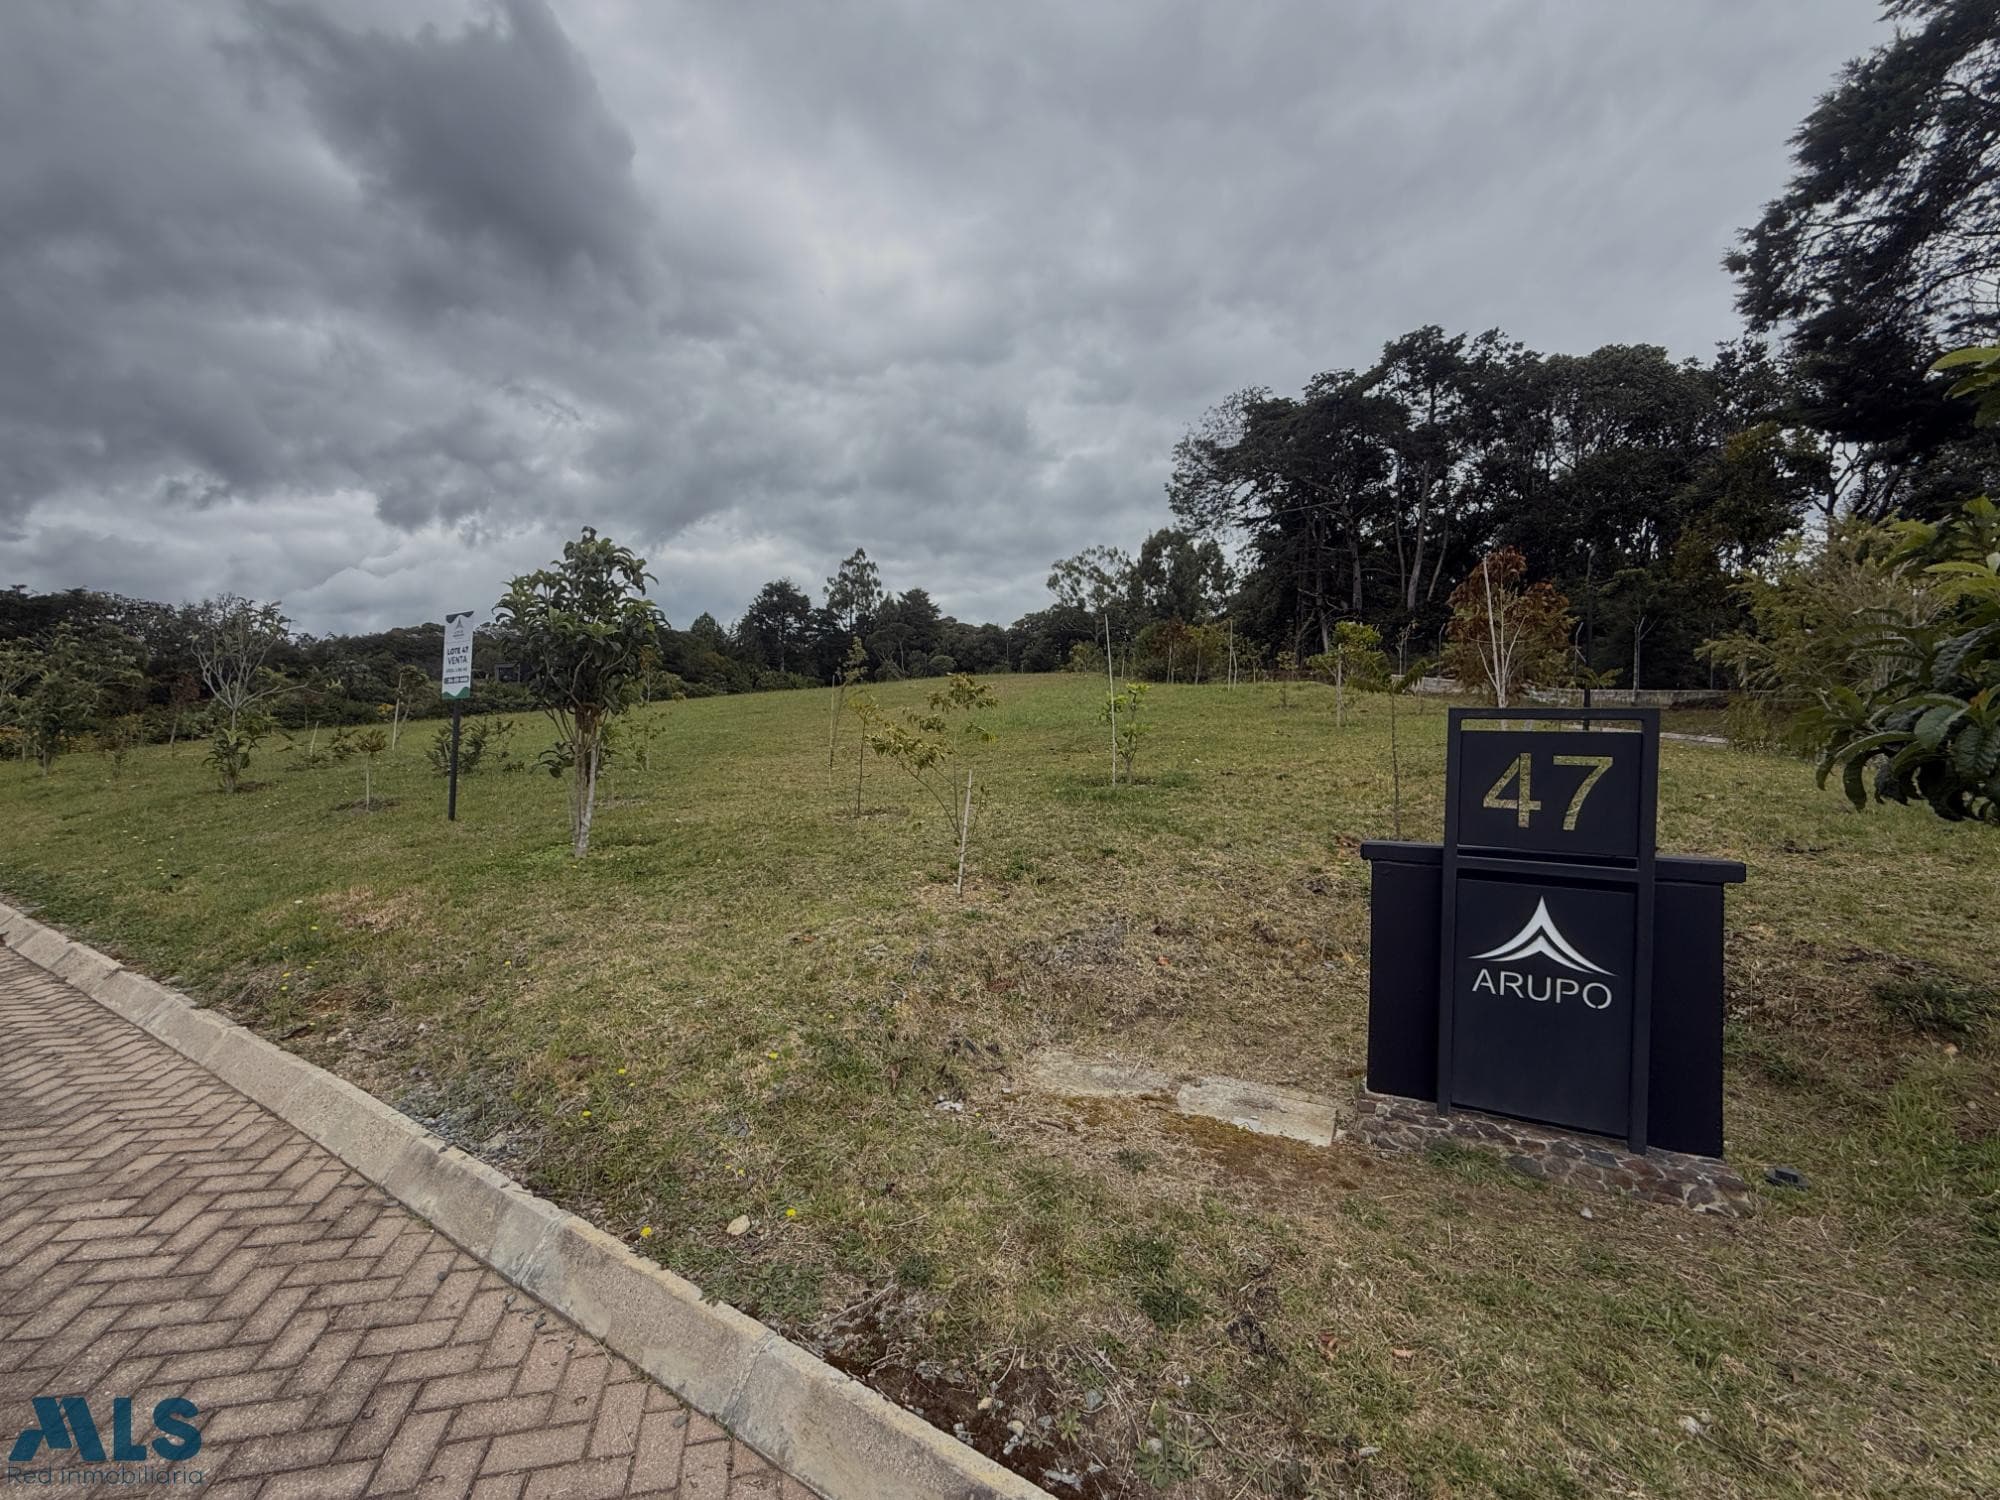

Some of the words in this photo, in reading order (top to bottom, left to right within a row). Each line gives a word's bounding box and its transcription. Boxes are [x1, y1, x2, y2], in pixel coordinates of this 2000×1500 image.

[447, 647, 461, 656] LOTE
[461, 645, 469, 654] 47
[447, 655, 467, 665] VENTA
[1482, 752, 1615, 832] 47
[1471, 967, 1613, 1010] ARUPO
